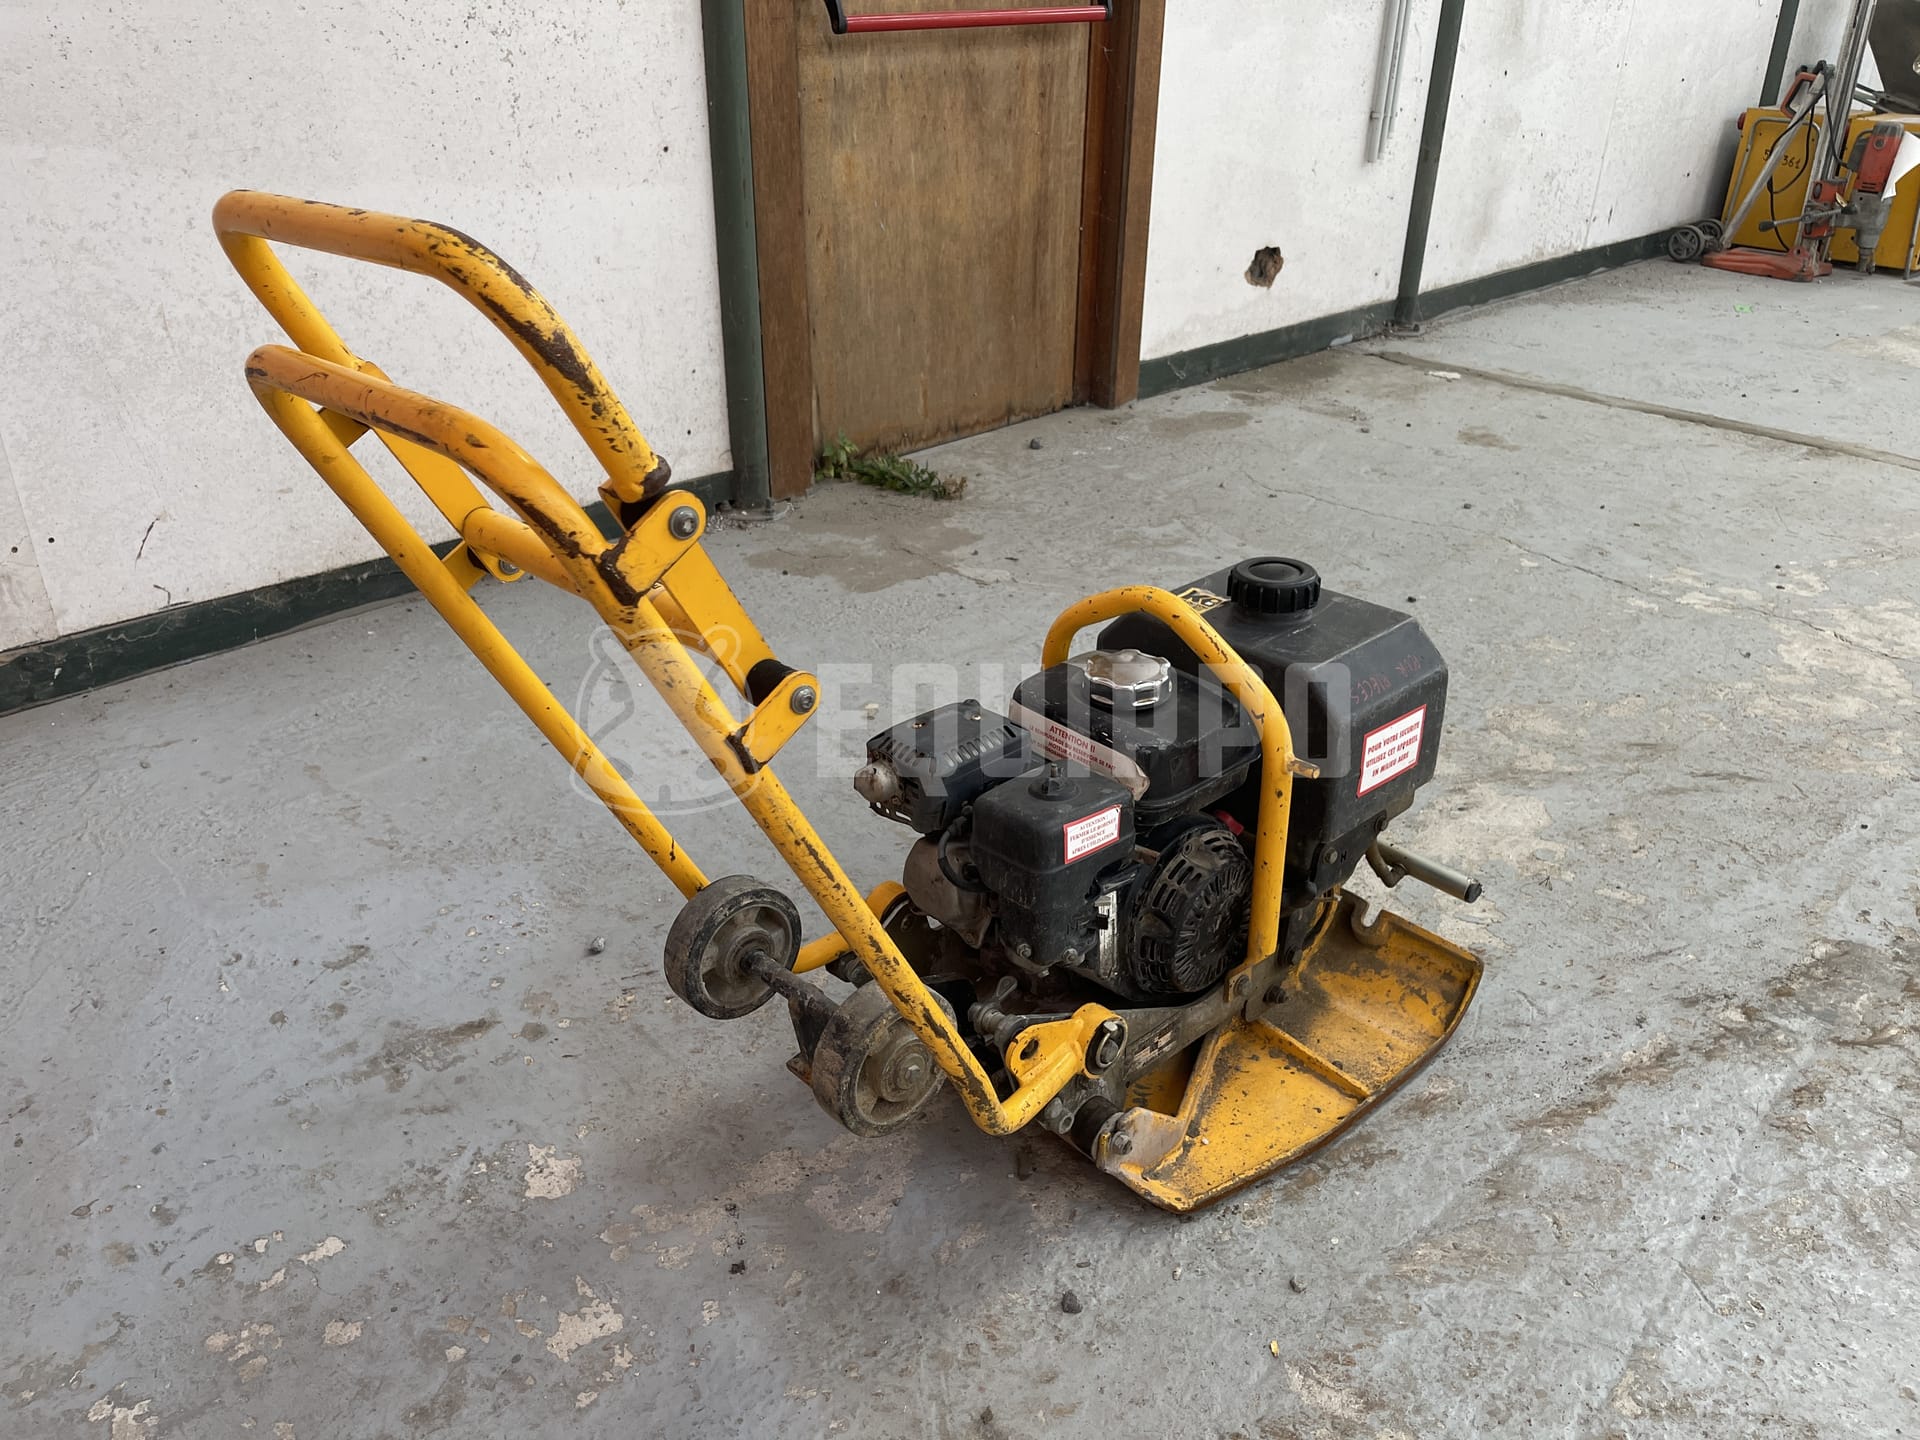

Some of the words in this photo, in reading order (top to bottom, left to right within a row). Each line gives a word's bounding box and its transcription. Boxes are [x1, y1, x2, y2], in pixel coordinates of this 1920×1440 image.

[1782, 155, 1800, 169] 361
[1049, 725, 1089, 750] ATTENTION
[1367, 742, 1382, 755] POUR
[1383, 732, 1399, 747] VOTRE
[1048, 742, 1067, 754] MOTEUR
[1366, 752, 1386, 768] UTILISEZ
[1387, 747, 1396, 757] CET
[1397, 734, 1418, 752] APPAREIL
[1372, 768, 1379, 777] EN
[1380, 758, 1397, 773] MILIEU
[1070, 830, 1089, 842] FERMER
